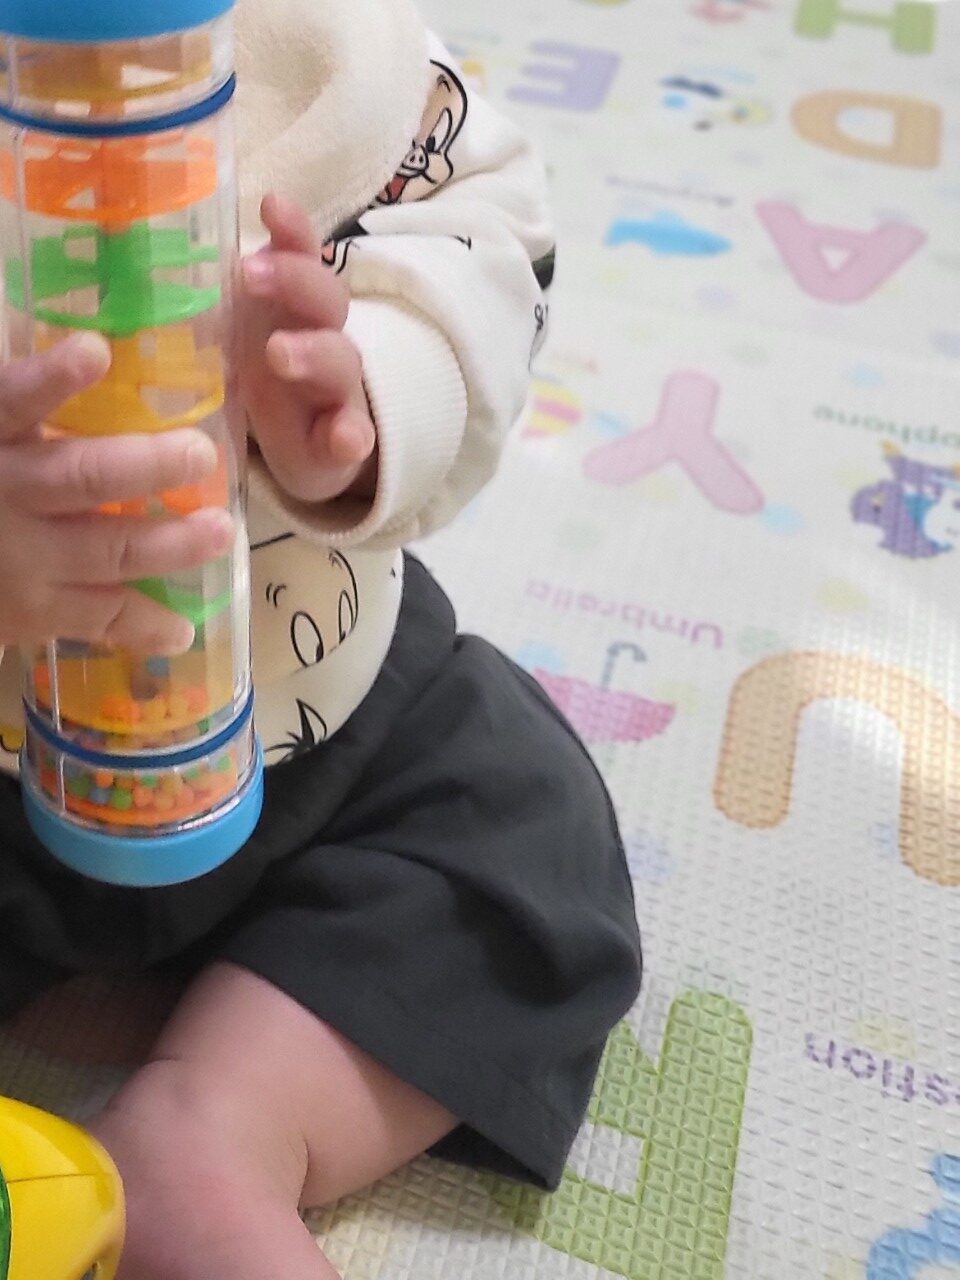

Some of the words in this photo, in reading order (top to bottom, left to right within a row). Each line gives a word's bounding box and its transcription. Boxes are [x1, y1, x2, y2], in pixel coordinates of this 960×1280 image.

[504, 40, 622, 112] E
[790, 91, 944, 170] D
[755, 200, 926, 304] A
[582, 370, 765, 516] Y
[526, 577, 724, 649] Umbrella
[712, 650, 960, 887] U
[805, 1032, 960, 1105] stion
